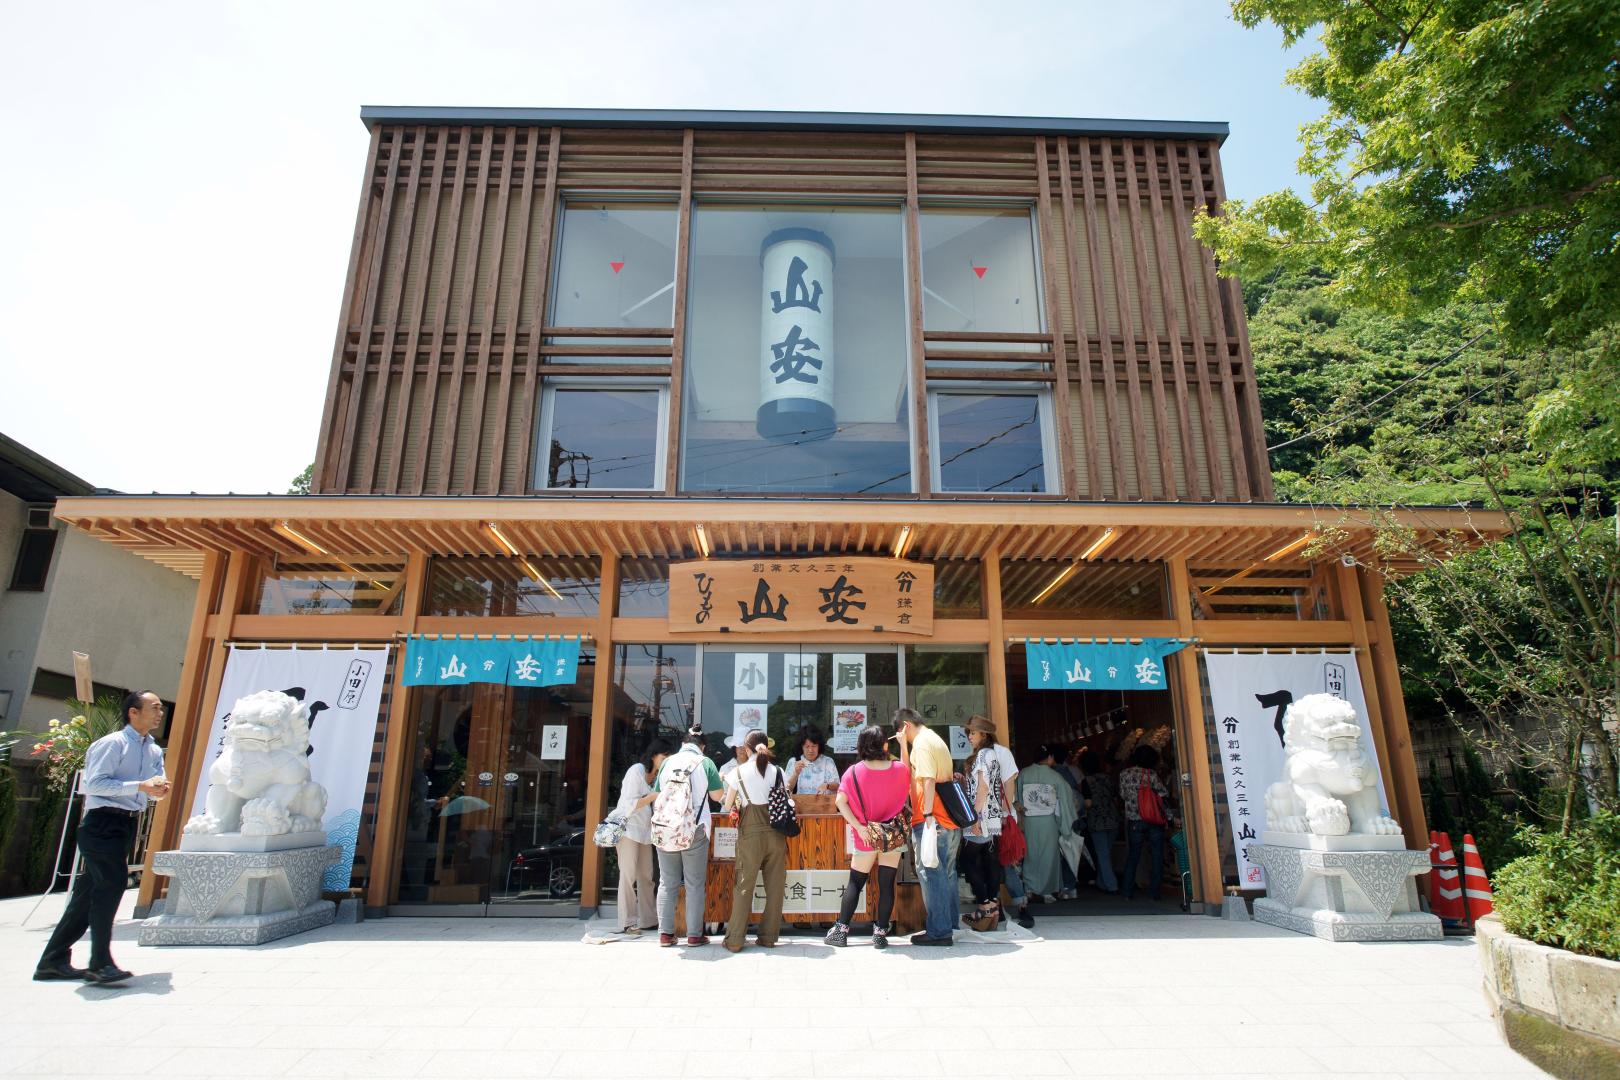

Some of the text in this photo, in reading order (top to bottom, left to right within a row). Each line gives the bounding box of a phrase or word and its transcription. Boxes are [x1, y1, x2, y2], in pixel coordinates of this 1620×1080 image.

[770, 256, 824, 385] 山安
[752, 563, 856, 573] 創業文久三年
[694, 572, 715, 624] ひもの
[737, 575, 867, 625] 山安
[896, 598, 913, 625] 鎌倉
[737, 662, 864, 691] 小田原
[1227, 739, 1251, 816] 創業文久三年
